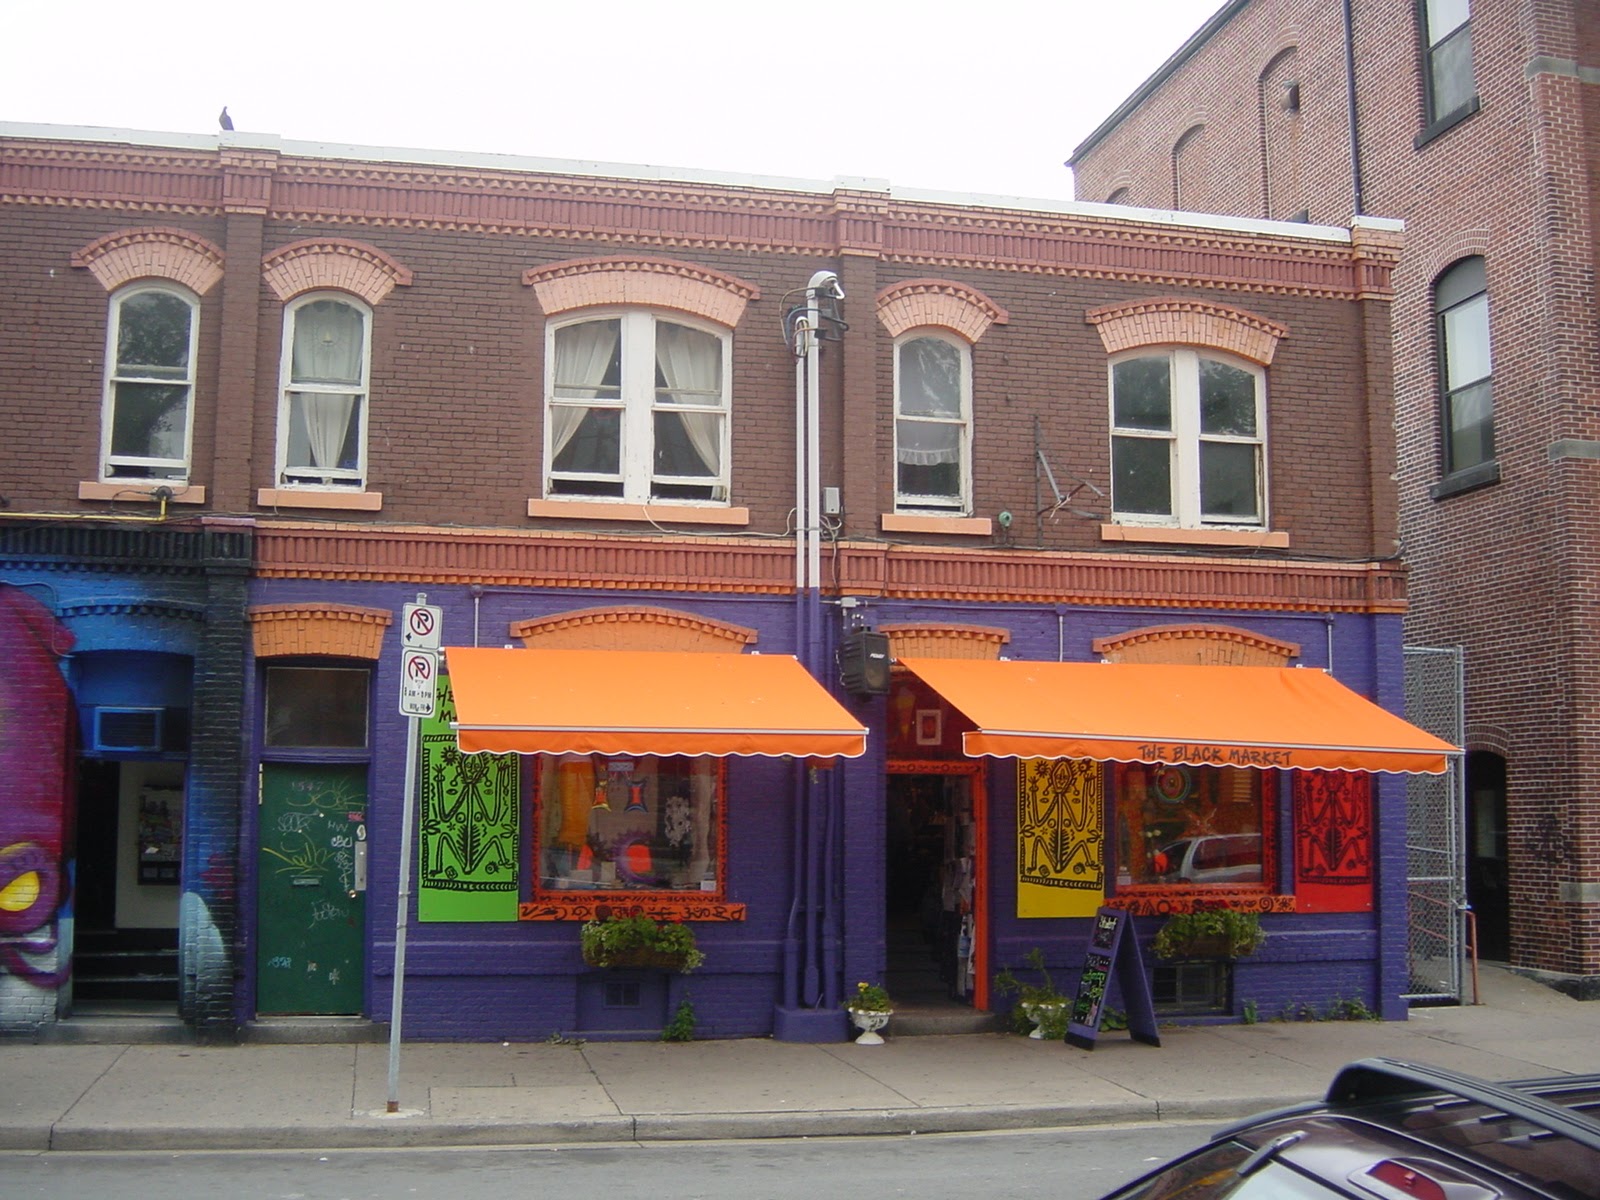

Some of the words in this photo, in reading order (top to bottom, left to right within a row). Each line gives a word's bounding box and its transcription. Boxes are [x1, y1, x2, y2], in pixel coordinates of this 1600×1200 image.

[1138, 744, 1167, 761] THE
[1172, 745, 1224, 763] BLACK
[1228, 748, 1293, 766] MARKET
